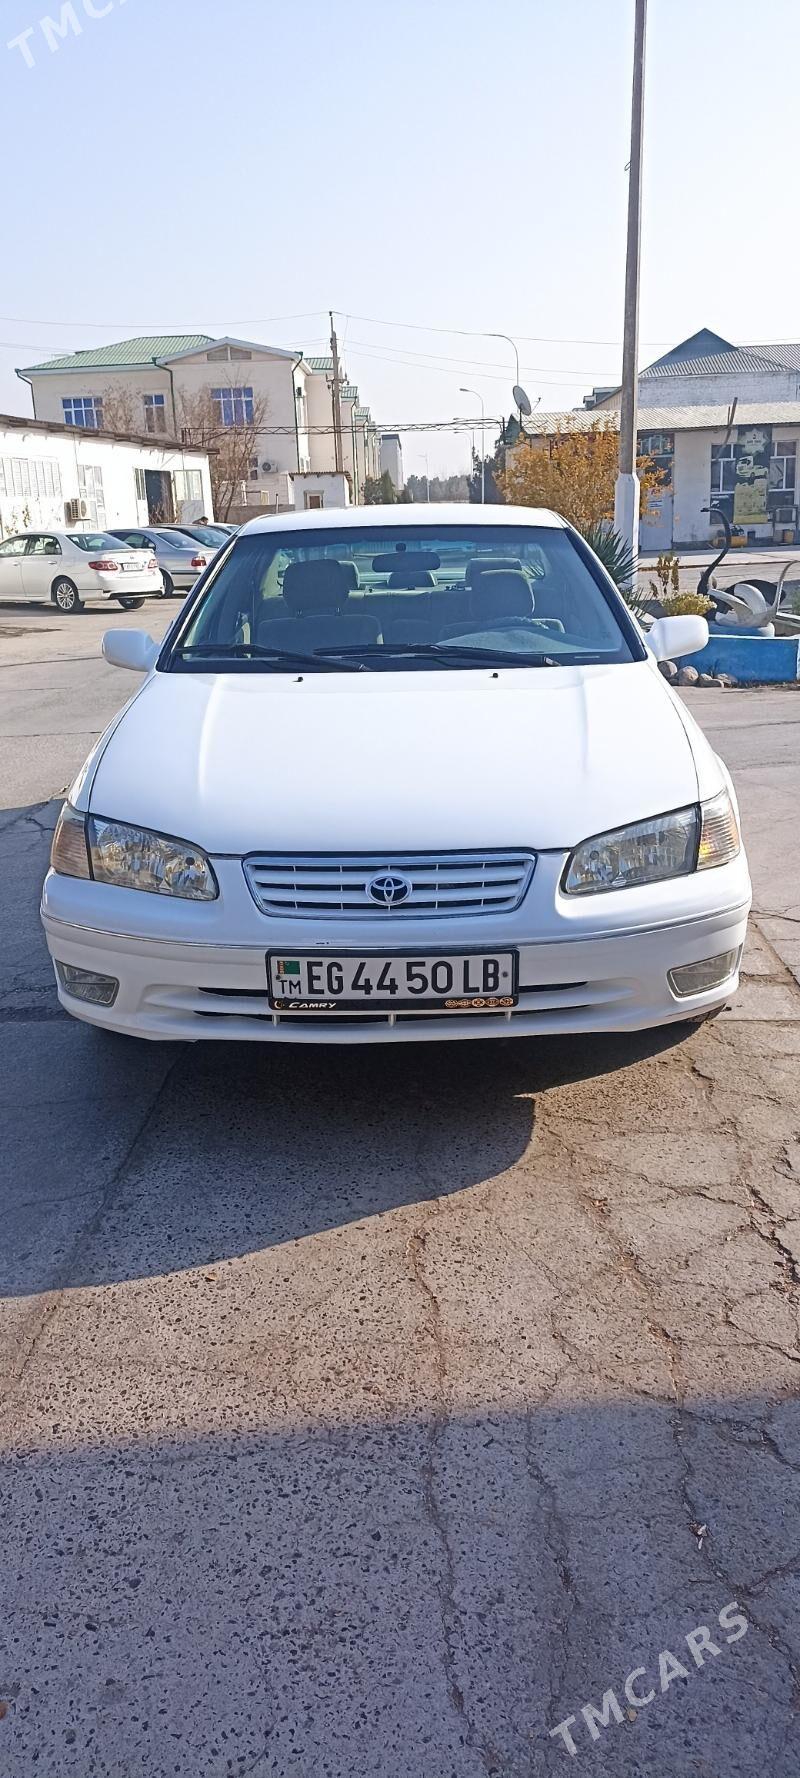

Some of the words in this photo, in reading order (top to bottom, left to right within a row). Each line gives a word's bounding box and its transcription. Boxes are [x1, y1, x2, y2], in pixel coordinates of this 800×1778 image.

[306, 961, 344, 995] EG
[463, 959, 500, 993] LB
[279, 980, 302, 995] TM
[288, 1001, 337, 1009] CAMRY
